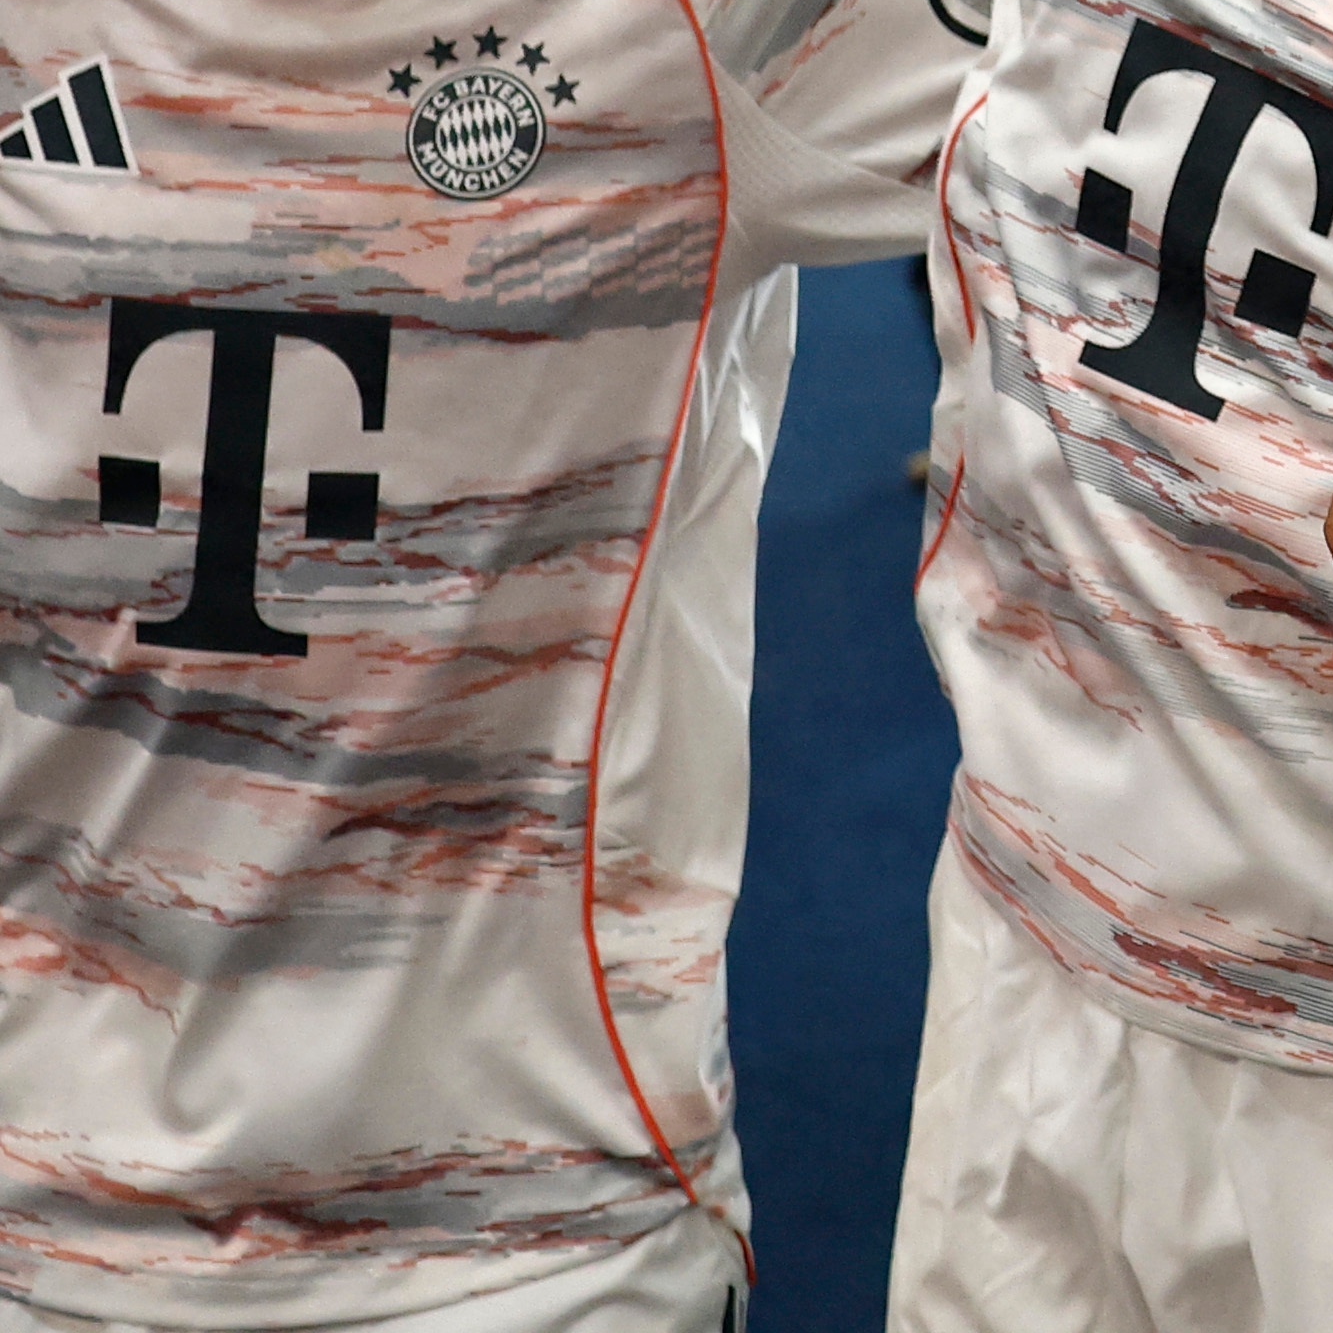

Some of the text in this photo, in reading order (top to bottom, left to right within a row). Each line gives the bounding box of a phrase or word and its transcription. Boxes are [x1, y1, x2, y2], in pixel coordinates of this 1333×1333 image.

[422, 76, 536, 128] FC BAYERN
[103, 297, 391, 657] T
